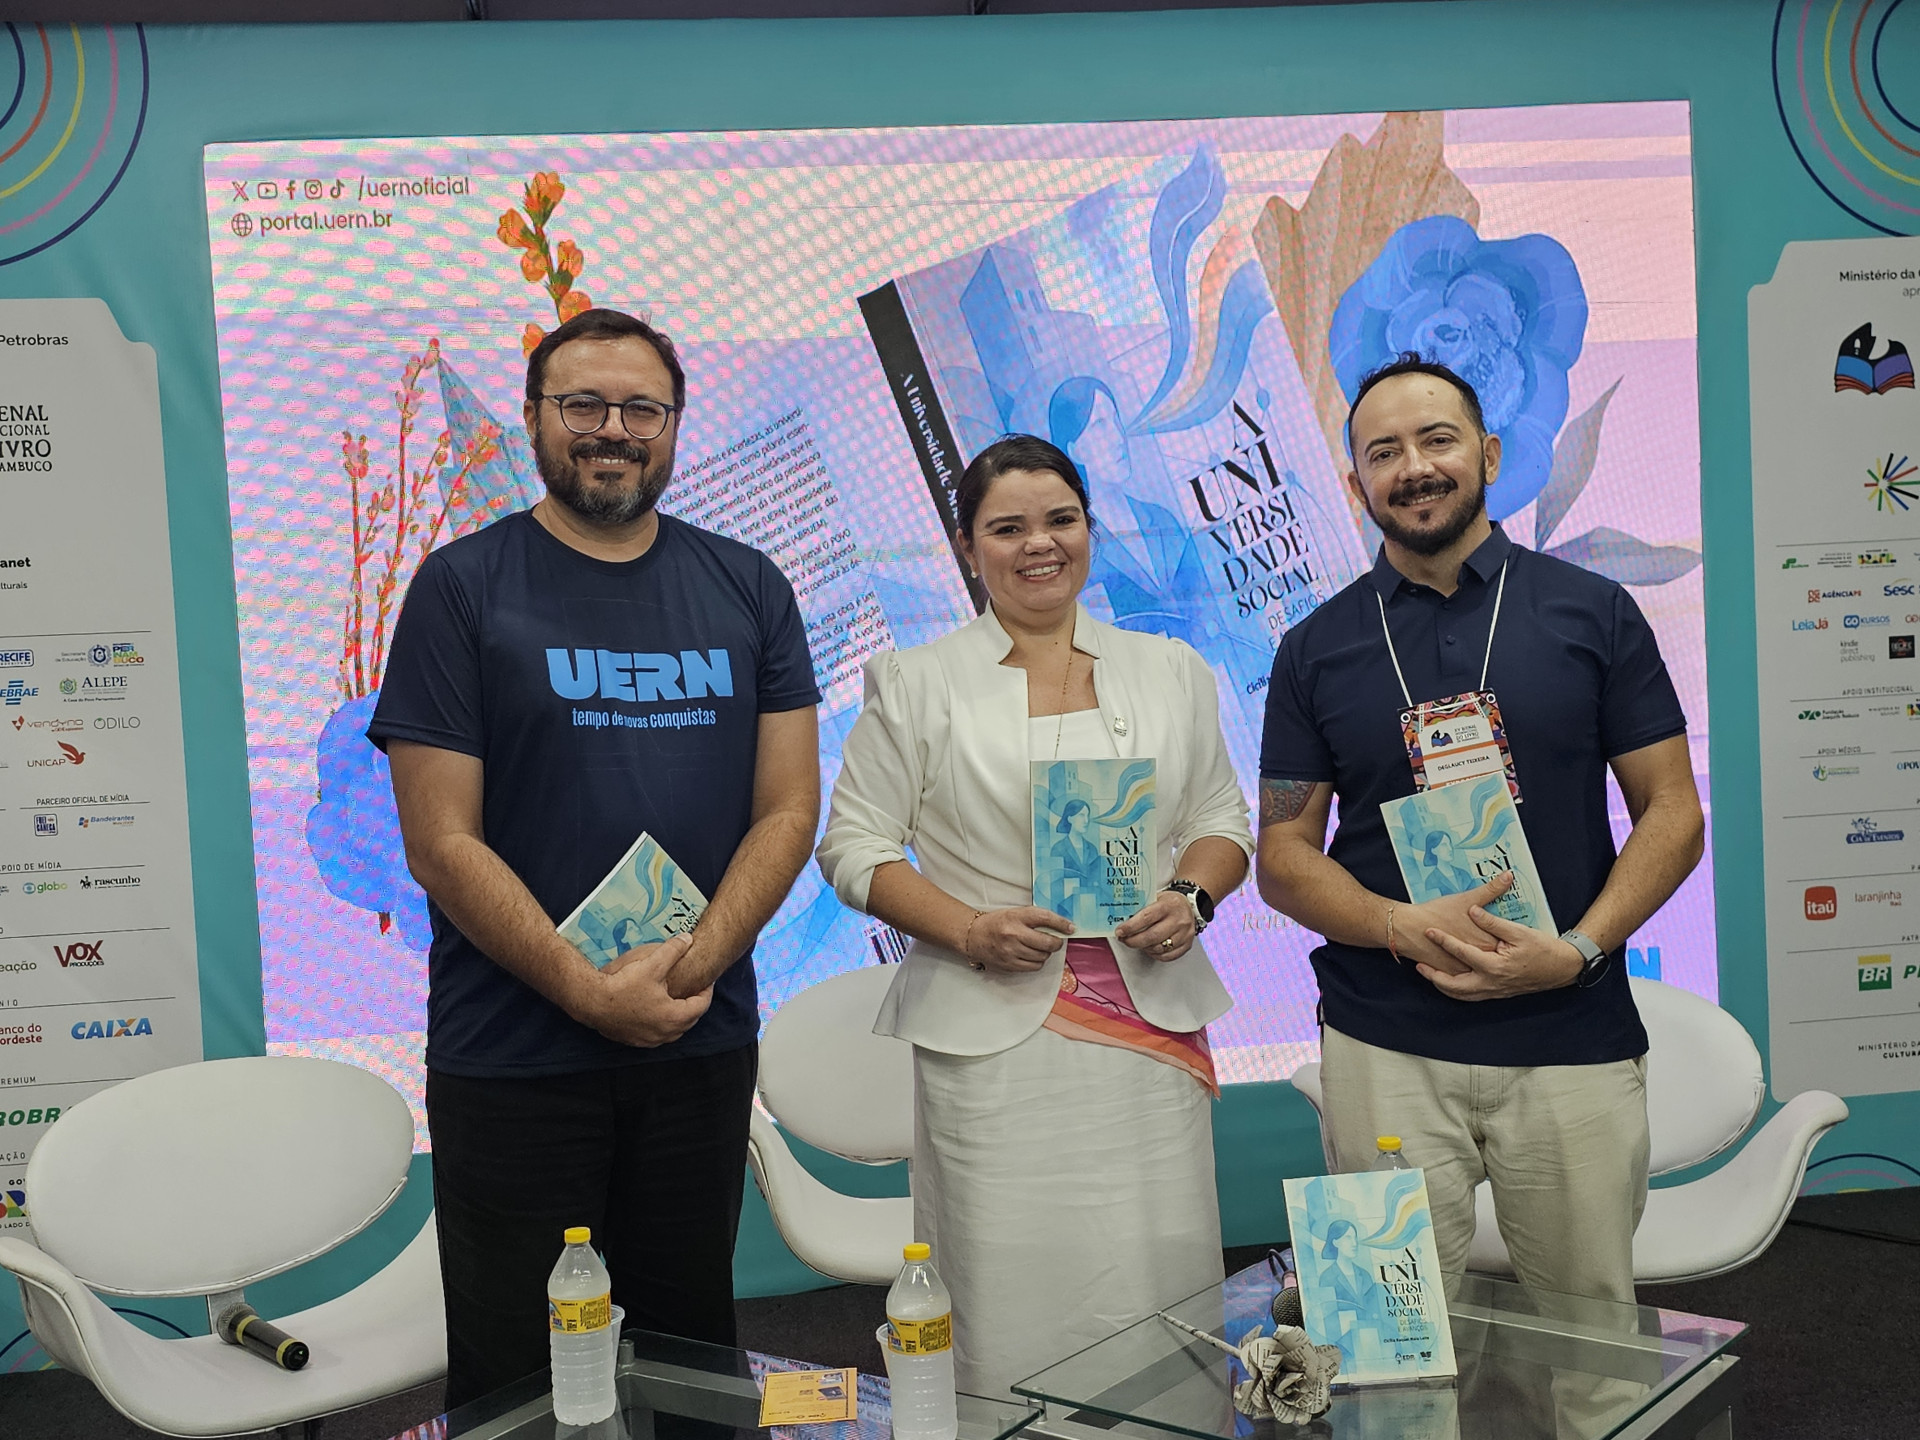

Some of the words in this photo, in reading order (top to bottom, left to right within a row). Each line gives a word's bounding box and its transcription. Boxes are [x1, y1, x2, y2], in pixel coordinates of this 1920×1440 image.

[358, 176, 469, 200] /uernoficial
[260, 210, 392, 237] portal.uern.br
[1839, 269, 1897, 281] Ministério
[1901, 268, 1915, 280] da
[0, 334, 69, 346] Petrobras
[1233, 400, 1265, 449] A
[815, 464, 826, 475] do
[1188, 438, 1282, 523] UNI
[1209, 490, 1296, 555] VERSI
[1222, 522, 1309, 593] DADE
[1237, 560, 1320, 619] SOCIAL
[1268, 590, 1326, 630] DESAFIOS
[1792, 617, 1828, 631] LeiaJá
[82, 676, 128, 688] ALEPE
[546, 648, 734, 702] UERN
[1842, 688, 1862, 696] APOIO
[1864, 685, 1914, 694] INSTITUCIONAL
[94, 717, 140, 729] ODILO
[572, 707, 610, 730] tempo
[611, 711, 624, 726] de
[624, 715, 649, 729] novas
[650, 707, 716, 730] conquistas
[27, 759, 66, 767] UNICAP
[36, 797, 70, 806] PARCEIRO
[72, 796, 98, 804] OFICIAL
[110, 794, 130, 802] MÍDIA
[91, 815, 135, 823] Bandeirantes
[1125, 826, 1138, 839] A
[1106, 840, 1138, 856] UNI
[38, 861, 62, 869] MÍDIA
[1107, 856, 1139, 867] VERSI
[1106, 866, 1139, 878] DADE
[37, 882, 68, 893] globo
[95, 875, 141, 886] rascunho
[1107, 877, 1140, 886] SOCIAL
[1855, 890, 1902, 904] laranjinha
[1807, 900, 1835, 915] itaú
[53, 940, 104, 967] VOX
[1861, 969, 1889, 983] BR
[28, 1023, 42, 1032] do
[71, 1018, 153, 1039] CAIXA
[1858, 1041, 1908, 1051] MINISTÉRIO
[1401, 1247, 1416, 1263] A
[1379, 1263, 1419, 1283] UNI
[1383, 1282, 1423, 1296] VERSI
[1386, 1294, 1425, 1308] DADE
[1387, 1307, 1427, 1318] SOCIAL
